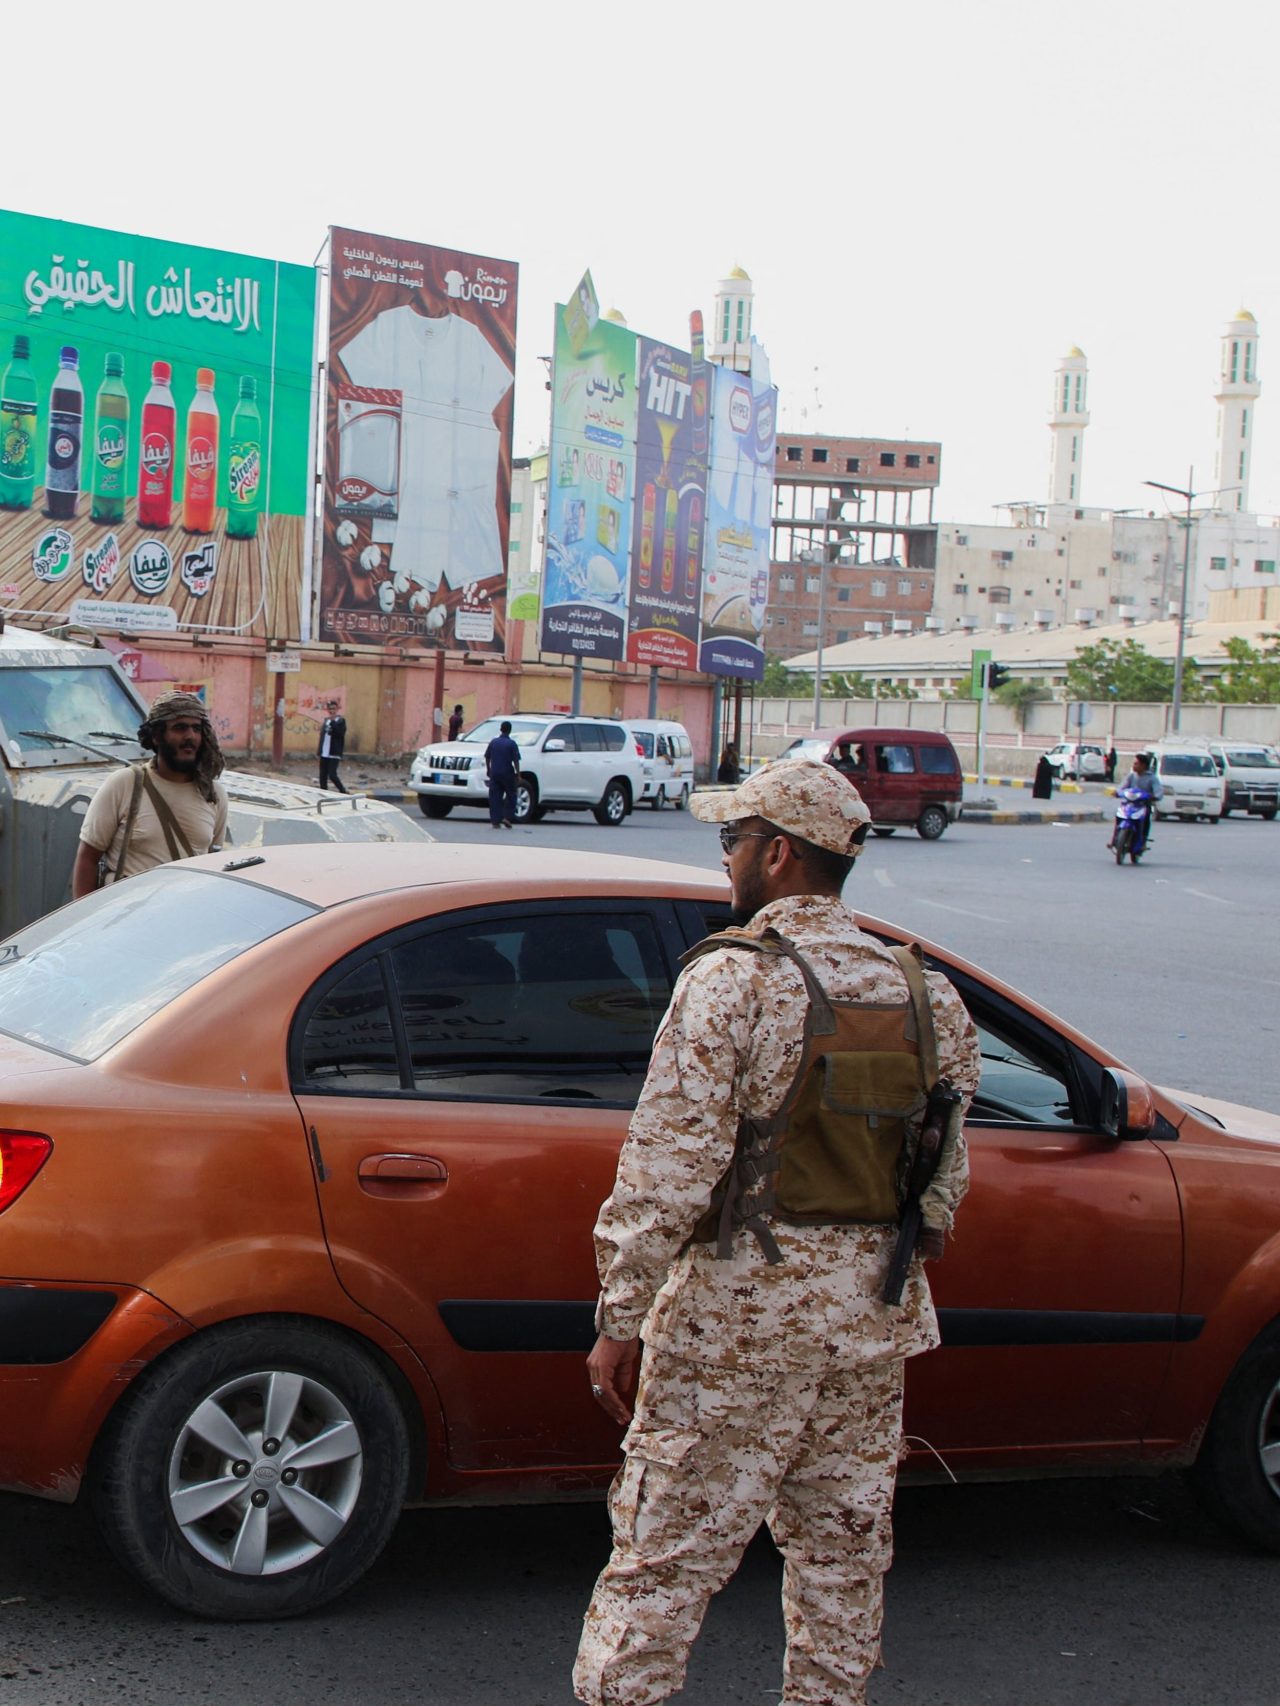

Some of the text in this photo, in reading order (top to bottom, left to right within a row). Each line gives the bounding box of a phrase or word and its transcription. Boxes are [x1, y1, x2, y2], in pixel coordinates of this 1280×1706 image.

[343, 247, 375, 261] الداخلية
[376, 254, 398, 268] ريمون
[343, 264, 371, 280] الأصلي
[372, 270, 397, 283] القطن
[25, 253, 261, 332] الانتعاش الحقيقي
[461, 277, 507, 308] ريمون
[586, 372, 626, 403] كريس
[646, 365, 692, 420] HIT
[229, 449, 259, 493] Stream
[86, 536, 114, 579] Stream
[133, 551, 169, 577] فيفا
